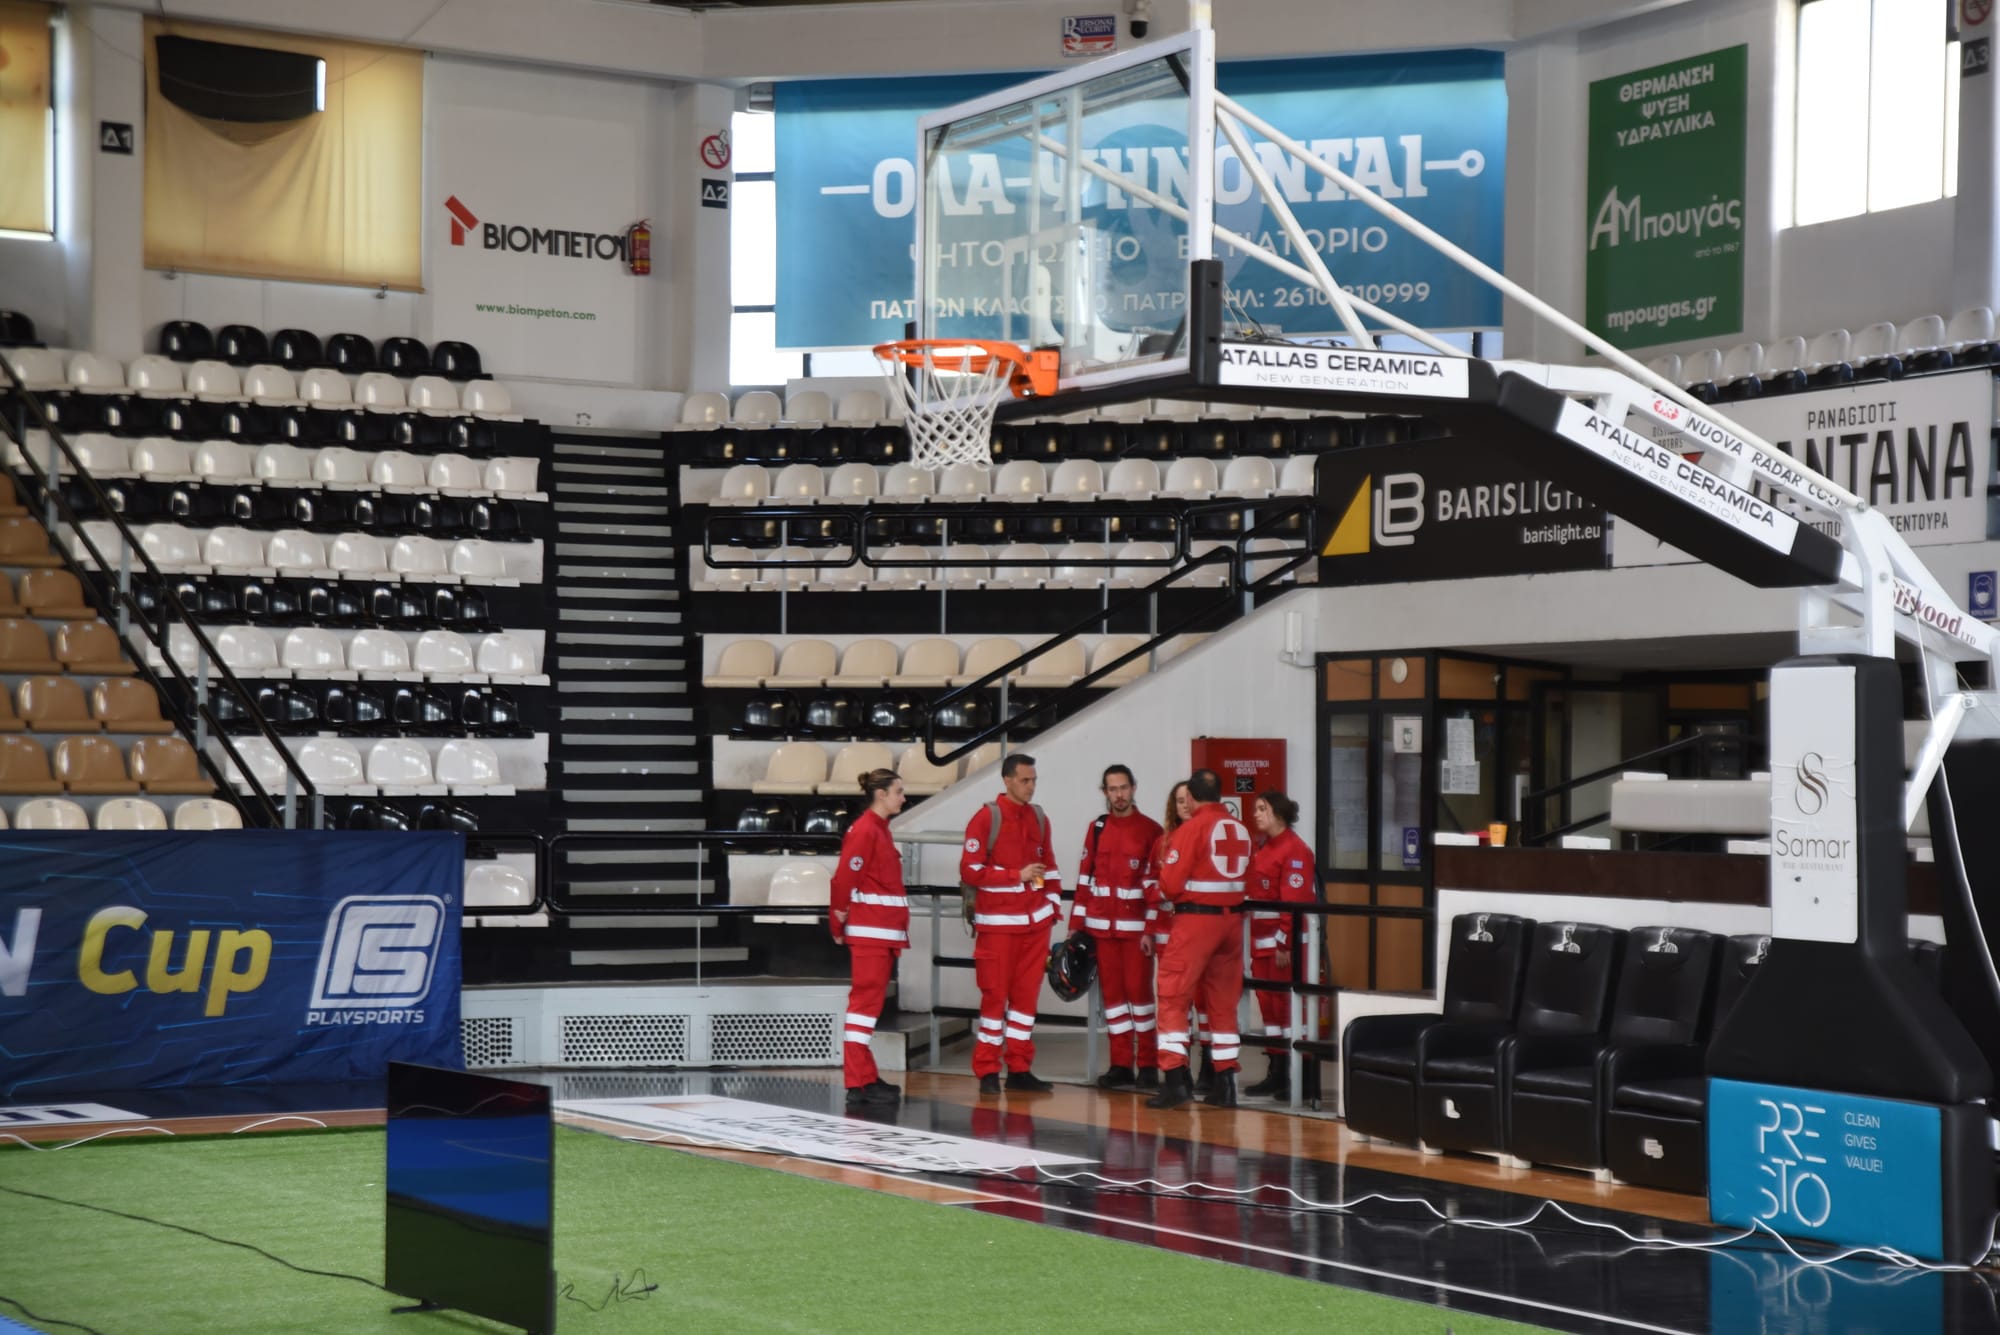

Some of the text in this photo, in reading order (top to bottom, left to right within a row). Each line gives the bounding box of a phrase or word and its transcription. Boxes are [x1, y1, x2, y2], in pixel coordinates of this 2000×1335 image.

[1965, 46, 1989, 68] Δ3
[1620, 63, 1715, 103] ΘΕΡΜΑΝΣΗ
[1642, 93, 1690, 119] ΨΥΞΗ
[1617, 110, 1716, 147] ΥΔΡΑΥΛΙΚΑ
[703, 184, 728, 202] Δ2
[476, 303, 597, 321] www.biompeton.com
[871, 297, 965, 319] ΠΑΤΩΝ
[1608, 296, 1717, 332] mpougas.gr
[1221, 348, 1444, 377] ATALLAS CERAMICA
[1256, 373, 1409, 391] NEW GENERATION
[1807, 401, 1897, 431] PANAGIOTI
[1685, 416, 1744, 456] NUOVA
[1752, 450, 1803, 487] RADAR
[1585, 415, 1775, 528] ATALLAS CERAMICA
[1612, 449, 1742, 525] NEW GENERATION
[1523, 523, 1600, 545] barislight.eu
[1776, 829, 1850, 859] Samar
[79, 905, 273, 1017] Cup
[306, 1010, 424, 1026] PLAYSPORTS
[1844, 1111, 1881, 1129] CLEAN
[1844, 1133, 1877, 1151] GIVES
[1844, 1154, 1883, 1173] VALUE!
